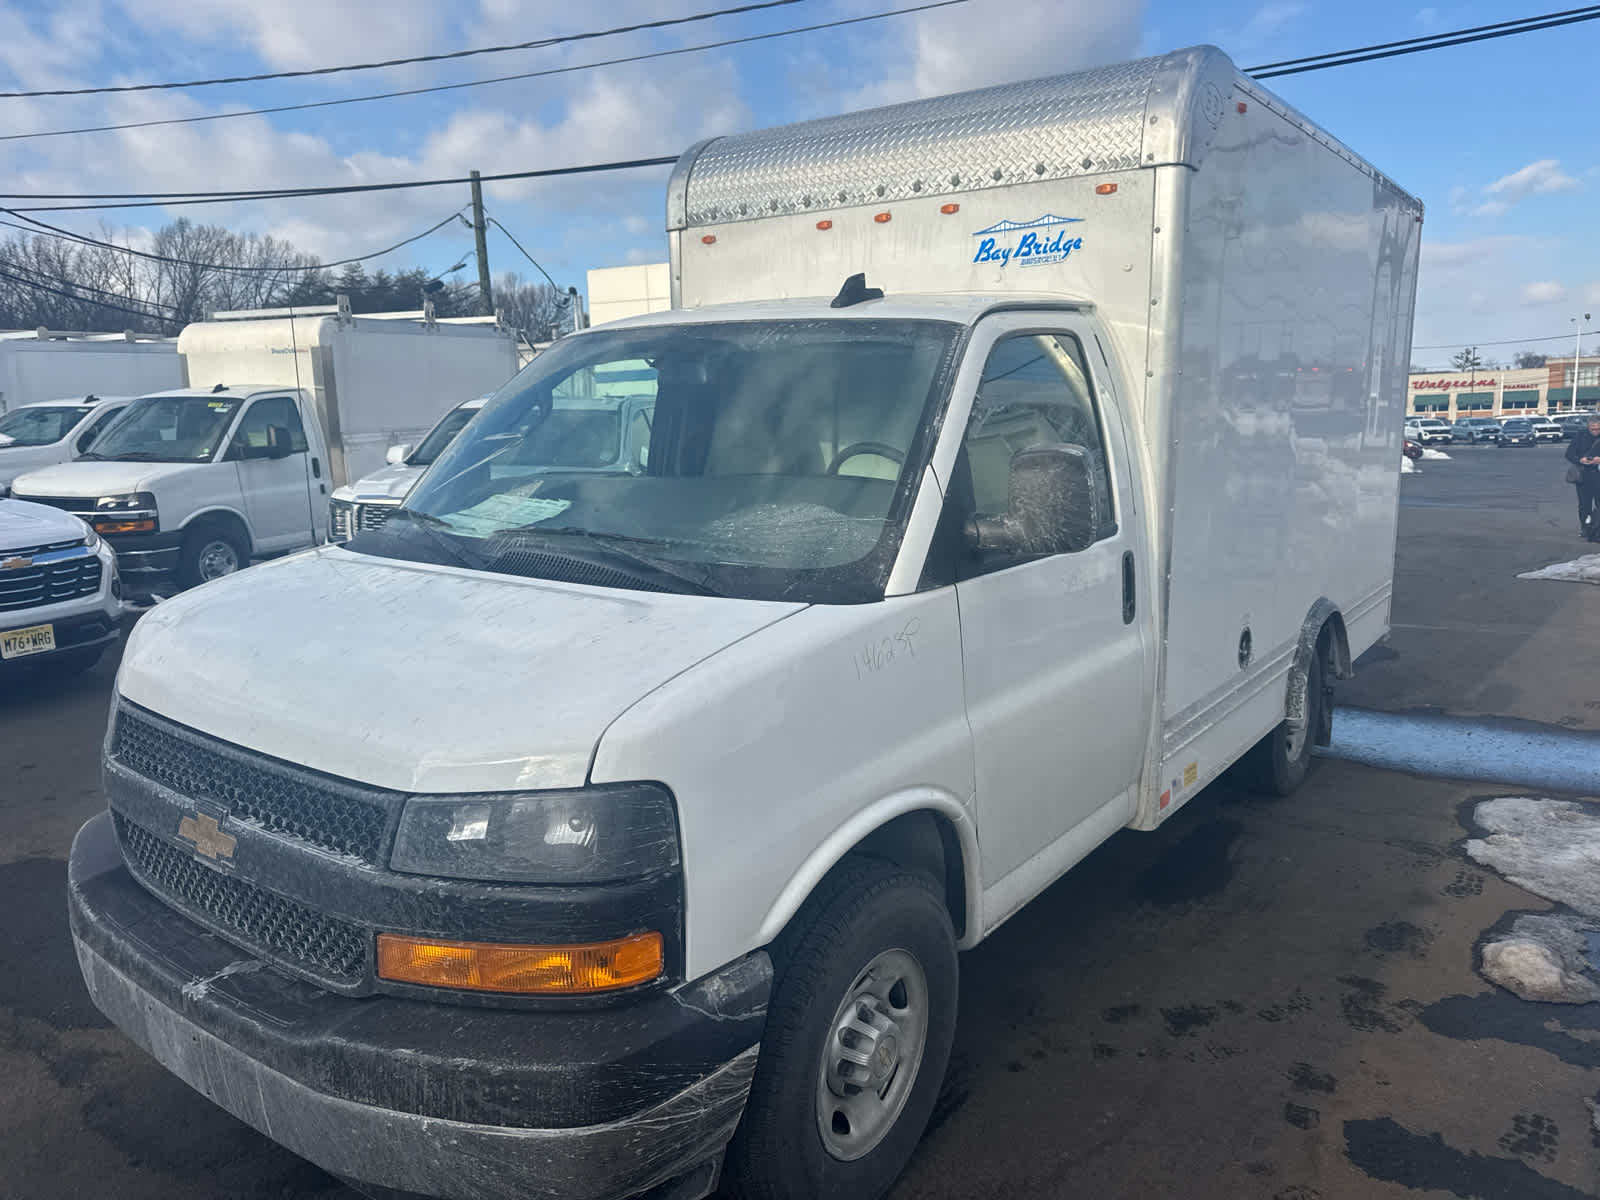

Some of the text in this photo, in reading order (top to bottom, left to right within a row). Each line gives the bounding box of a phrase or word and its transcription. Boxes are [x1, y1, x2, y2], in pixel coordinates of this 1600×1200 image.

[973, 236, 1013, 267] Bay
[1013, 229, 1083, 259] Bridge
[1412, 378, 1498, 391] Walgreens
